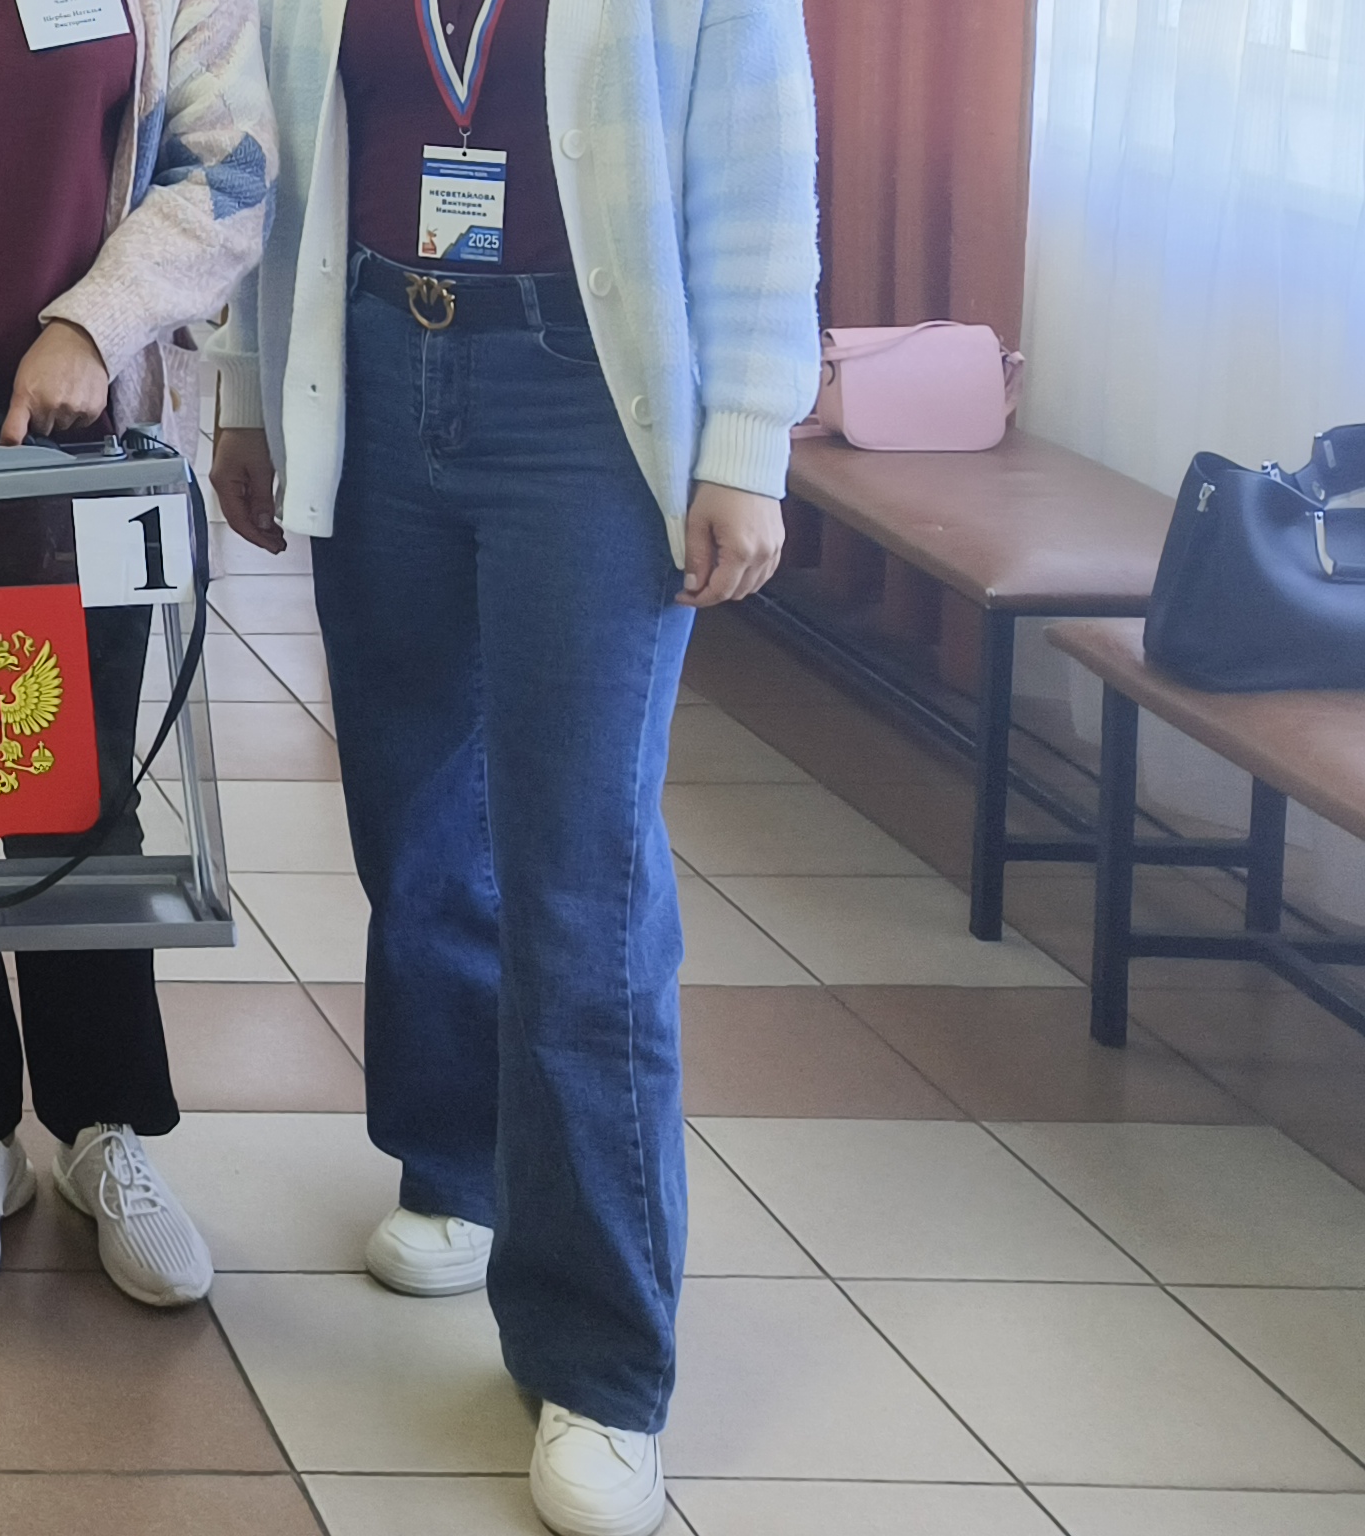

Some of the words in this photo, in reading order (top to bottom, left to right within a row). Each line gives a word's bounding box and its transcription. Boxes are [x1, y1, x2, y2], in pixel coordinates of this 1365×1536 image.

[429, 189, 496, 202] НЕСВЕТАЙЛОВА
[468, 233, 500, 249] 2025
[128, 505, 178, 591] 1
